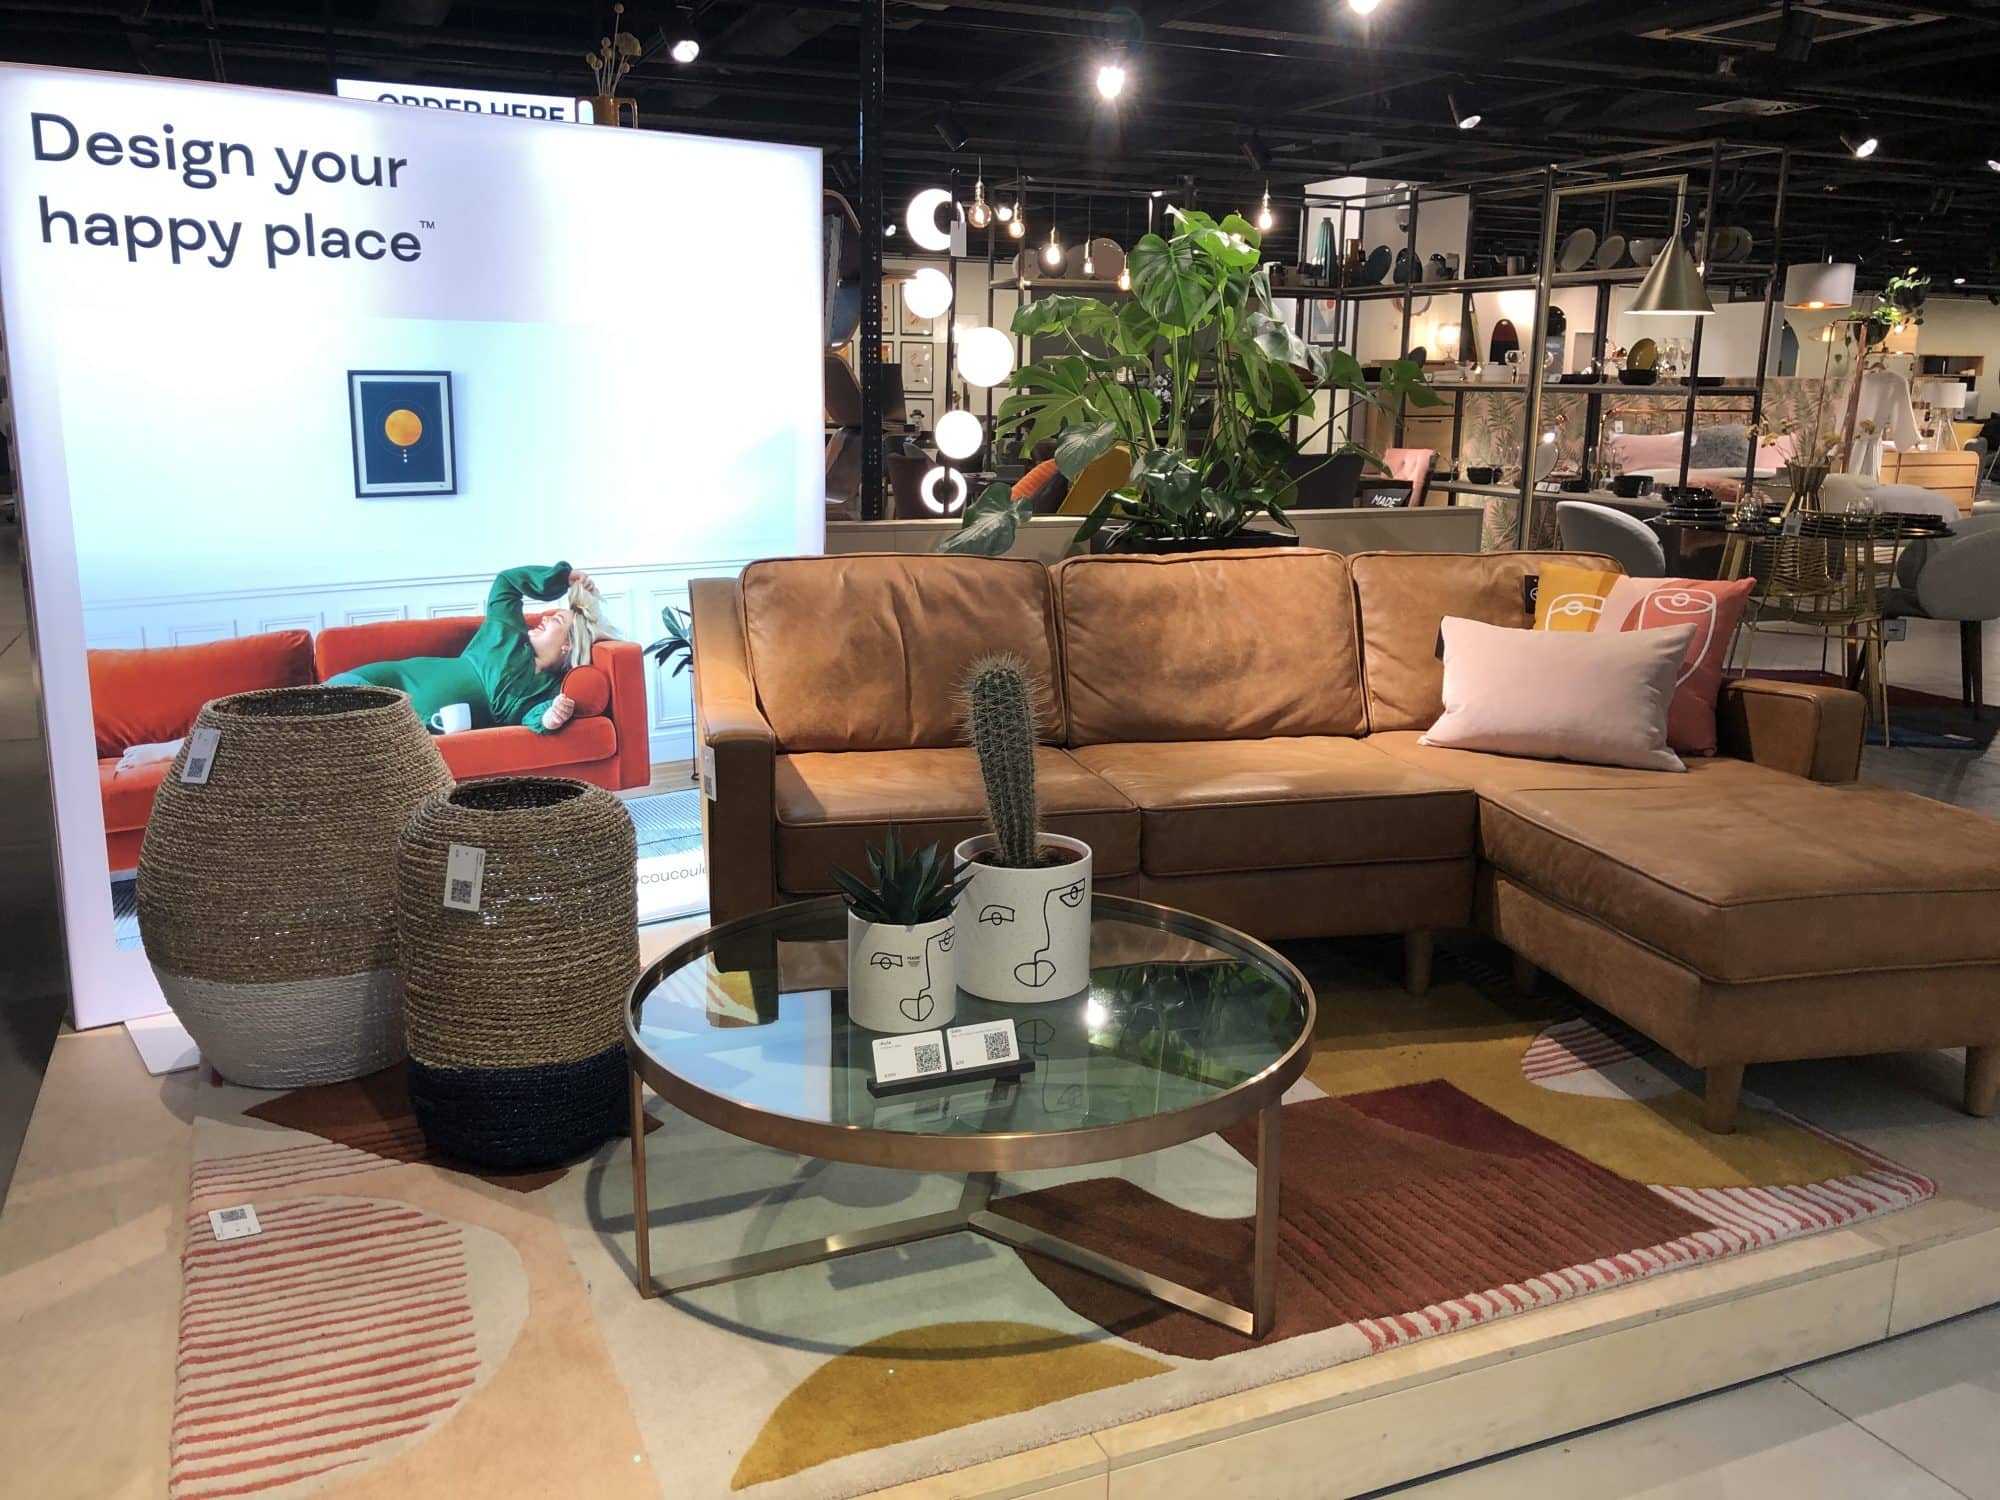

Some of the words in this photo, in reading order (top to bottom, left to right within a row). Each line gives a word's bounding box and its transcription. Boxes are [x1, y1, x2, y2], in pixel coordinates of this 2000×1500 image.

[30, 112, 255, 190] Design
[274, 147, 408, 196] your
[38, 195, 243, 269] happy
